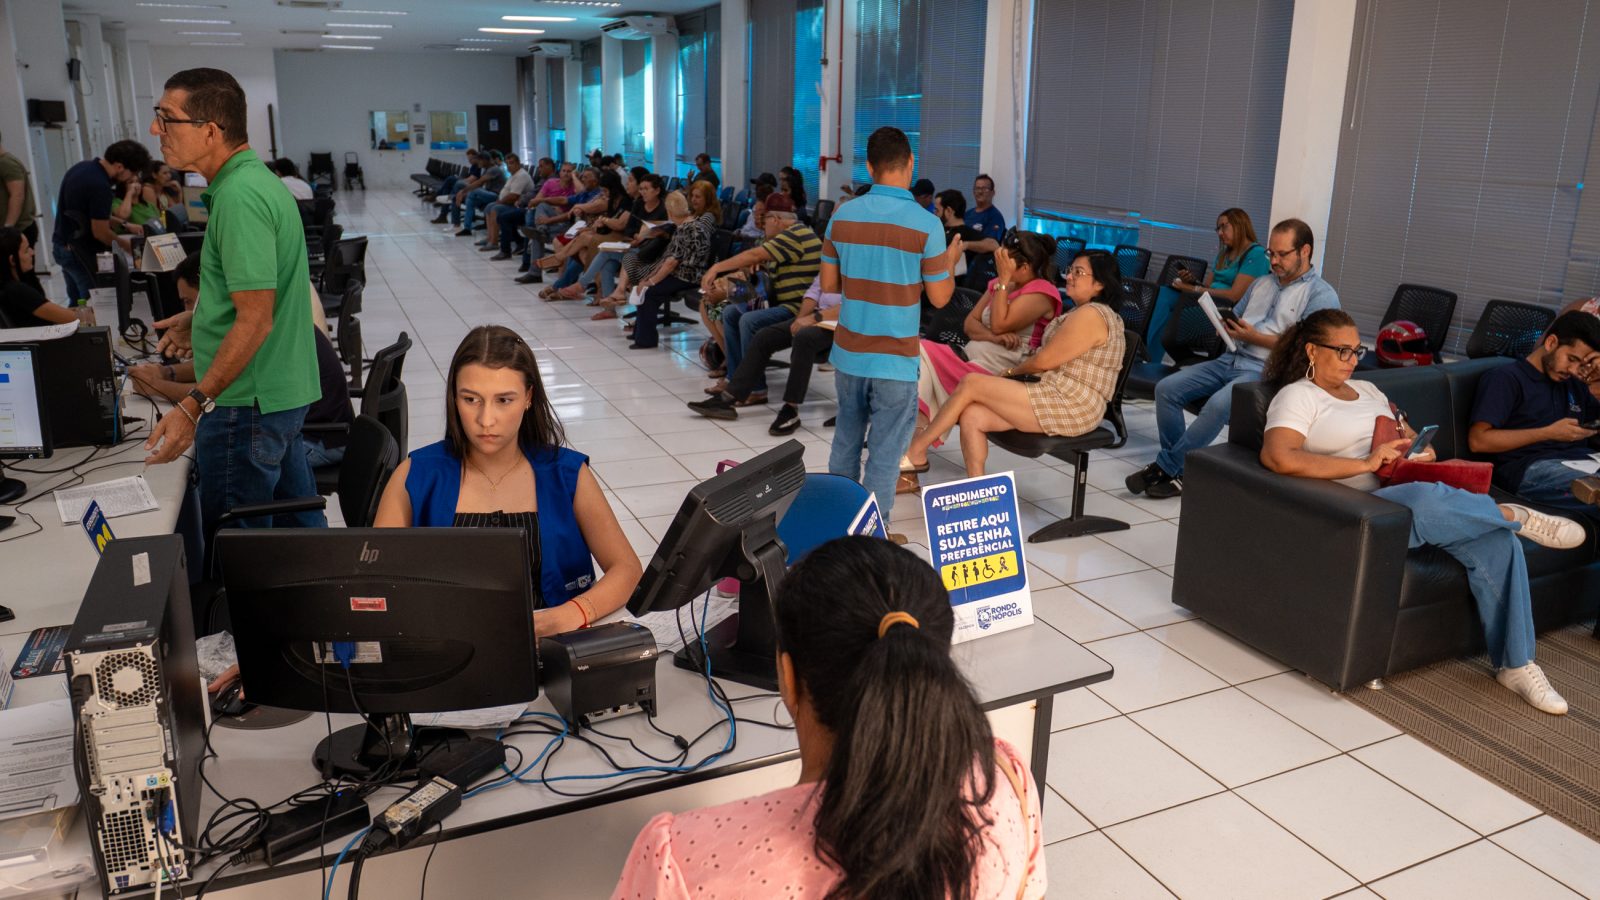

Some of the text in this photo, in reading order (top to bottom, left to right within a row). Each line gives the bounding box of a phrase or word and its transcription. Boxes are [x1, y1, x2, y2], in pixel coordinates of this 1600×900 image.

[932, 485, 1007, 508] ATENDIMENTO
[937, 511, 1010, 537] RETIRE AQUI
[939, 526, 1012, 551] SUA SENHA
[359, 541, 380, 564] hp
[940, 539, 1014, 563] PREFERÊNCIAL
[991, 602, 1017, 614] RONDO
